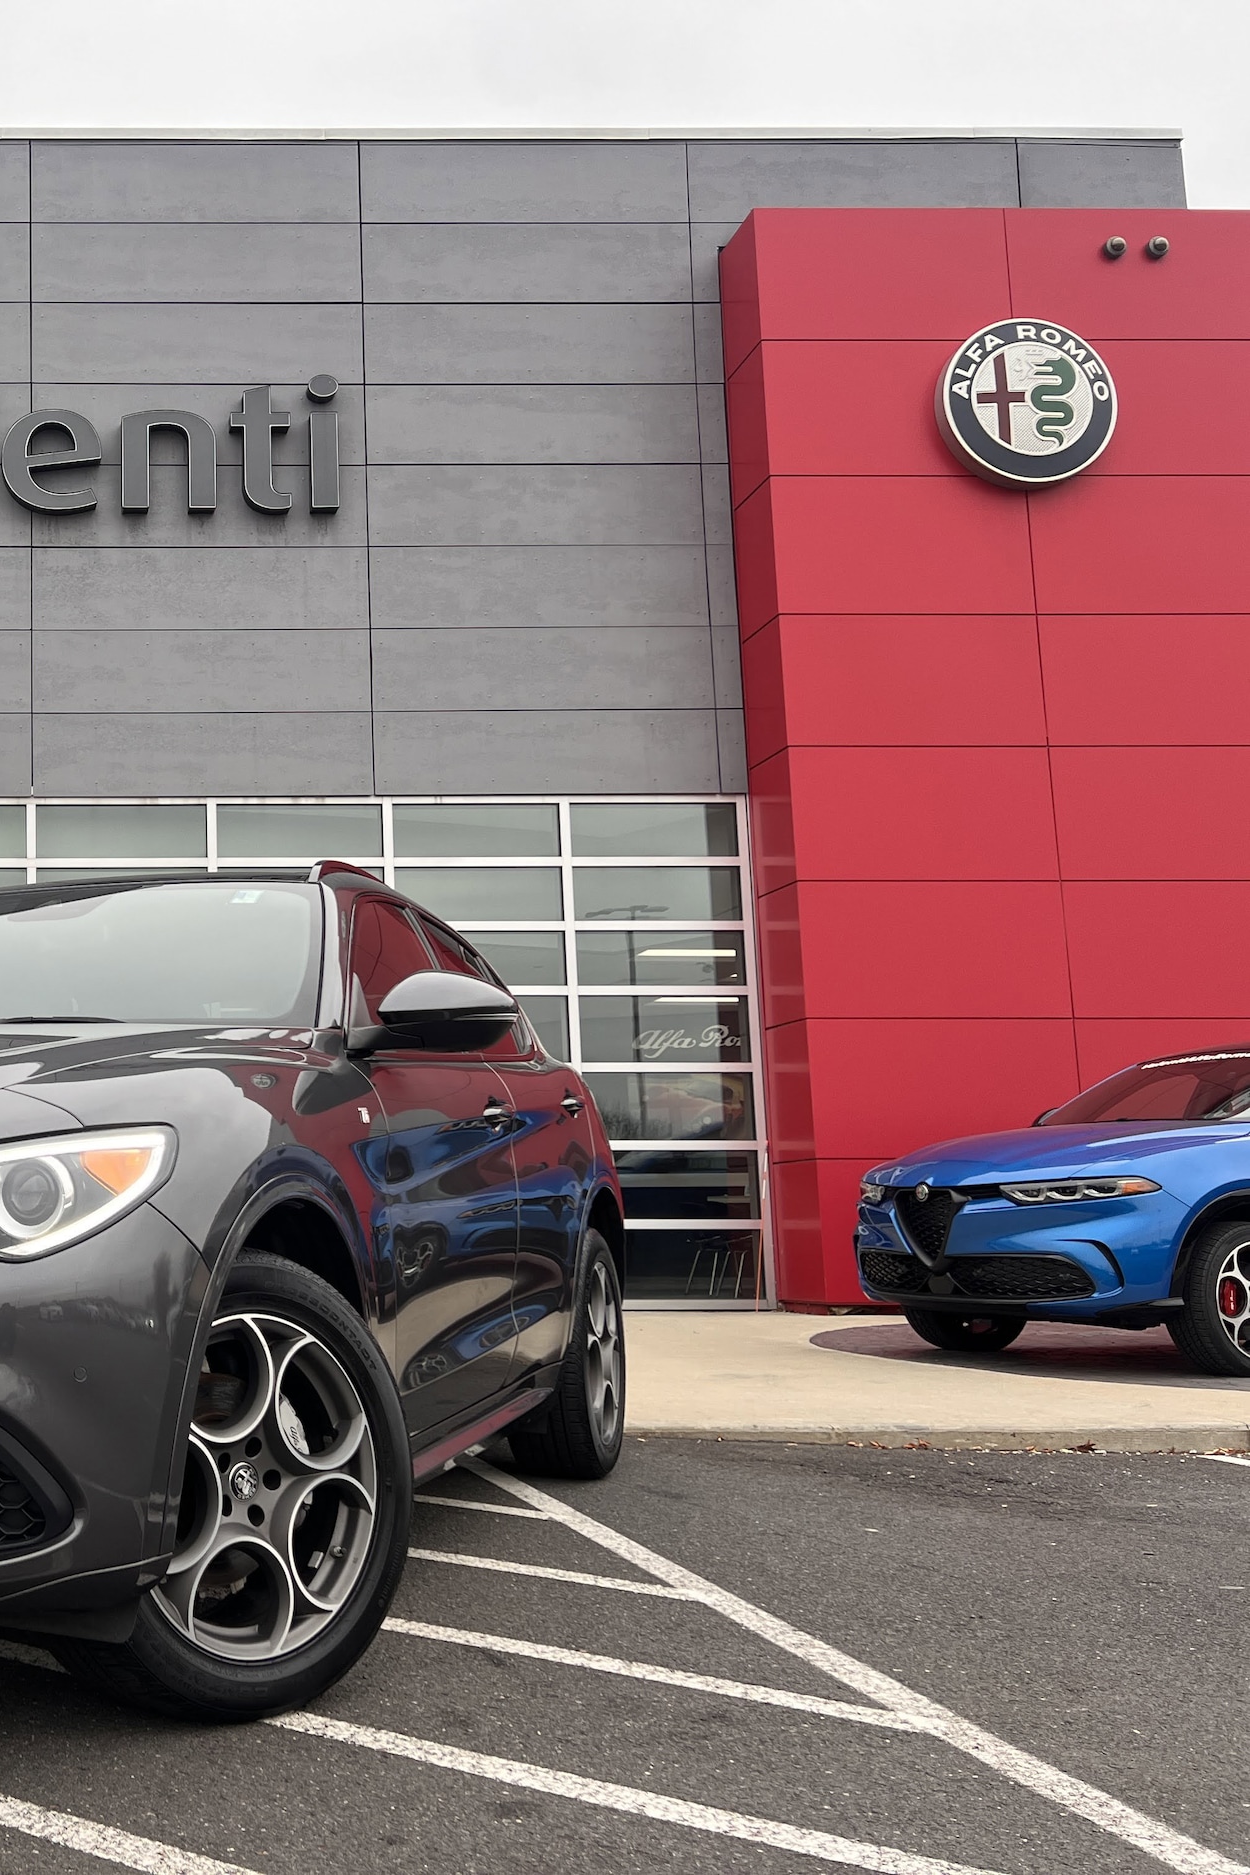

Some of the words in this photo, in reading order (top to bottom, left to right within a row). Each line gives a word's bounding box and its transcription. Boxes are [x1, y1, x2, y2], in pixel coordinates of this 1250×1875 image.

[951, 333, 1005, 400] ALFA
[1016, 324, 1110, 402] ROMEO
[631, 1029, 697, 1059] Alfa
[699, 1024, 741, 1048] Ro
